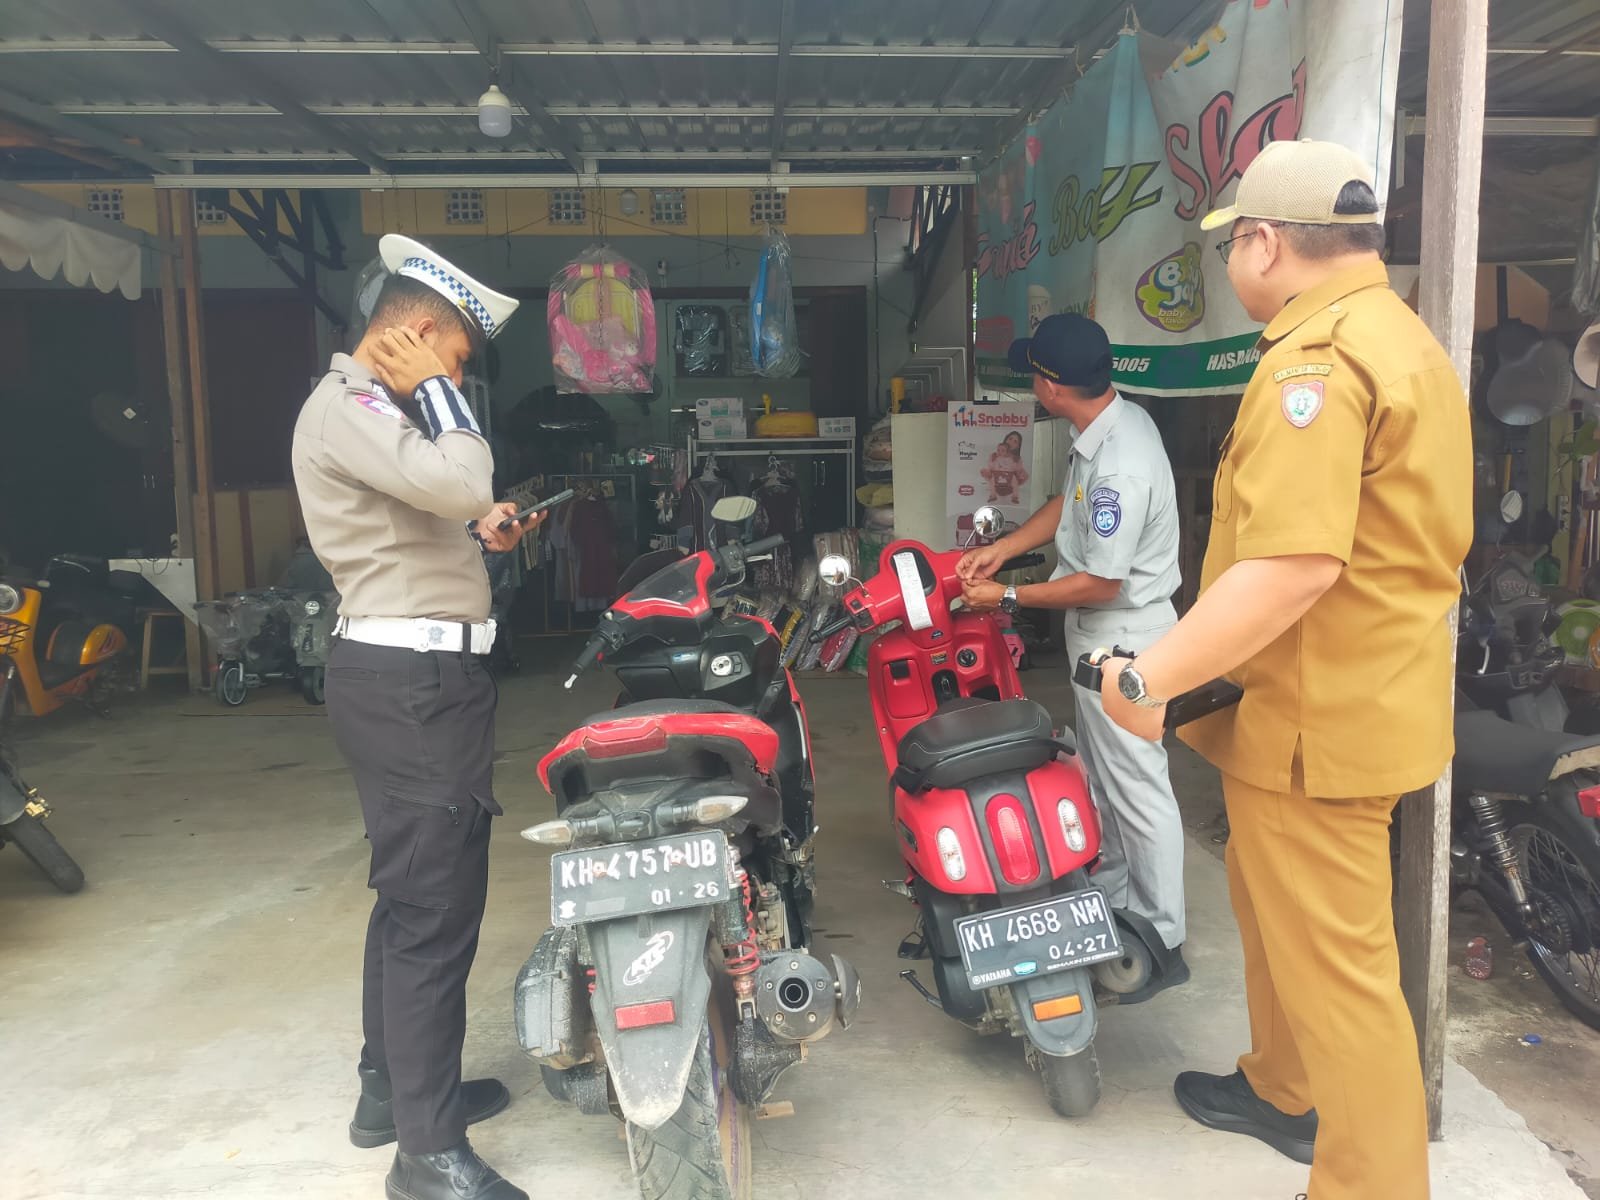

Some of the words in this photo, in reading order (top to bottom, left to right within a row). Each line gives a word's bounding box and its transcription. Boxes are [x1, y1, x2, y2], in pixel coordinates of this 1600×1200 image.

[978, 412, 1028, 427] Snobby
[561, 856, 593, 889] KH
[606, 845, 674, 881] 4757
[684, 838, 717, 869] UB
[964, 922, 995, 953] KH
[1006, 908, 1062, 943] 4668
[1069, 897, 1104, 927] NM
[980, 968, 1012, 984] YAMAHA
